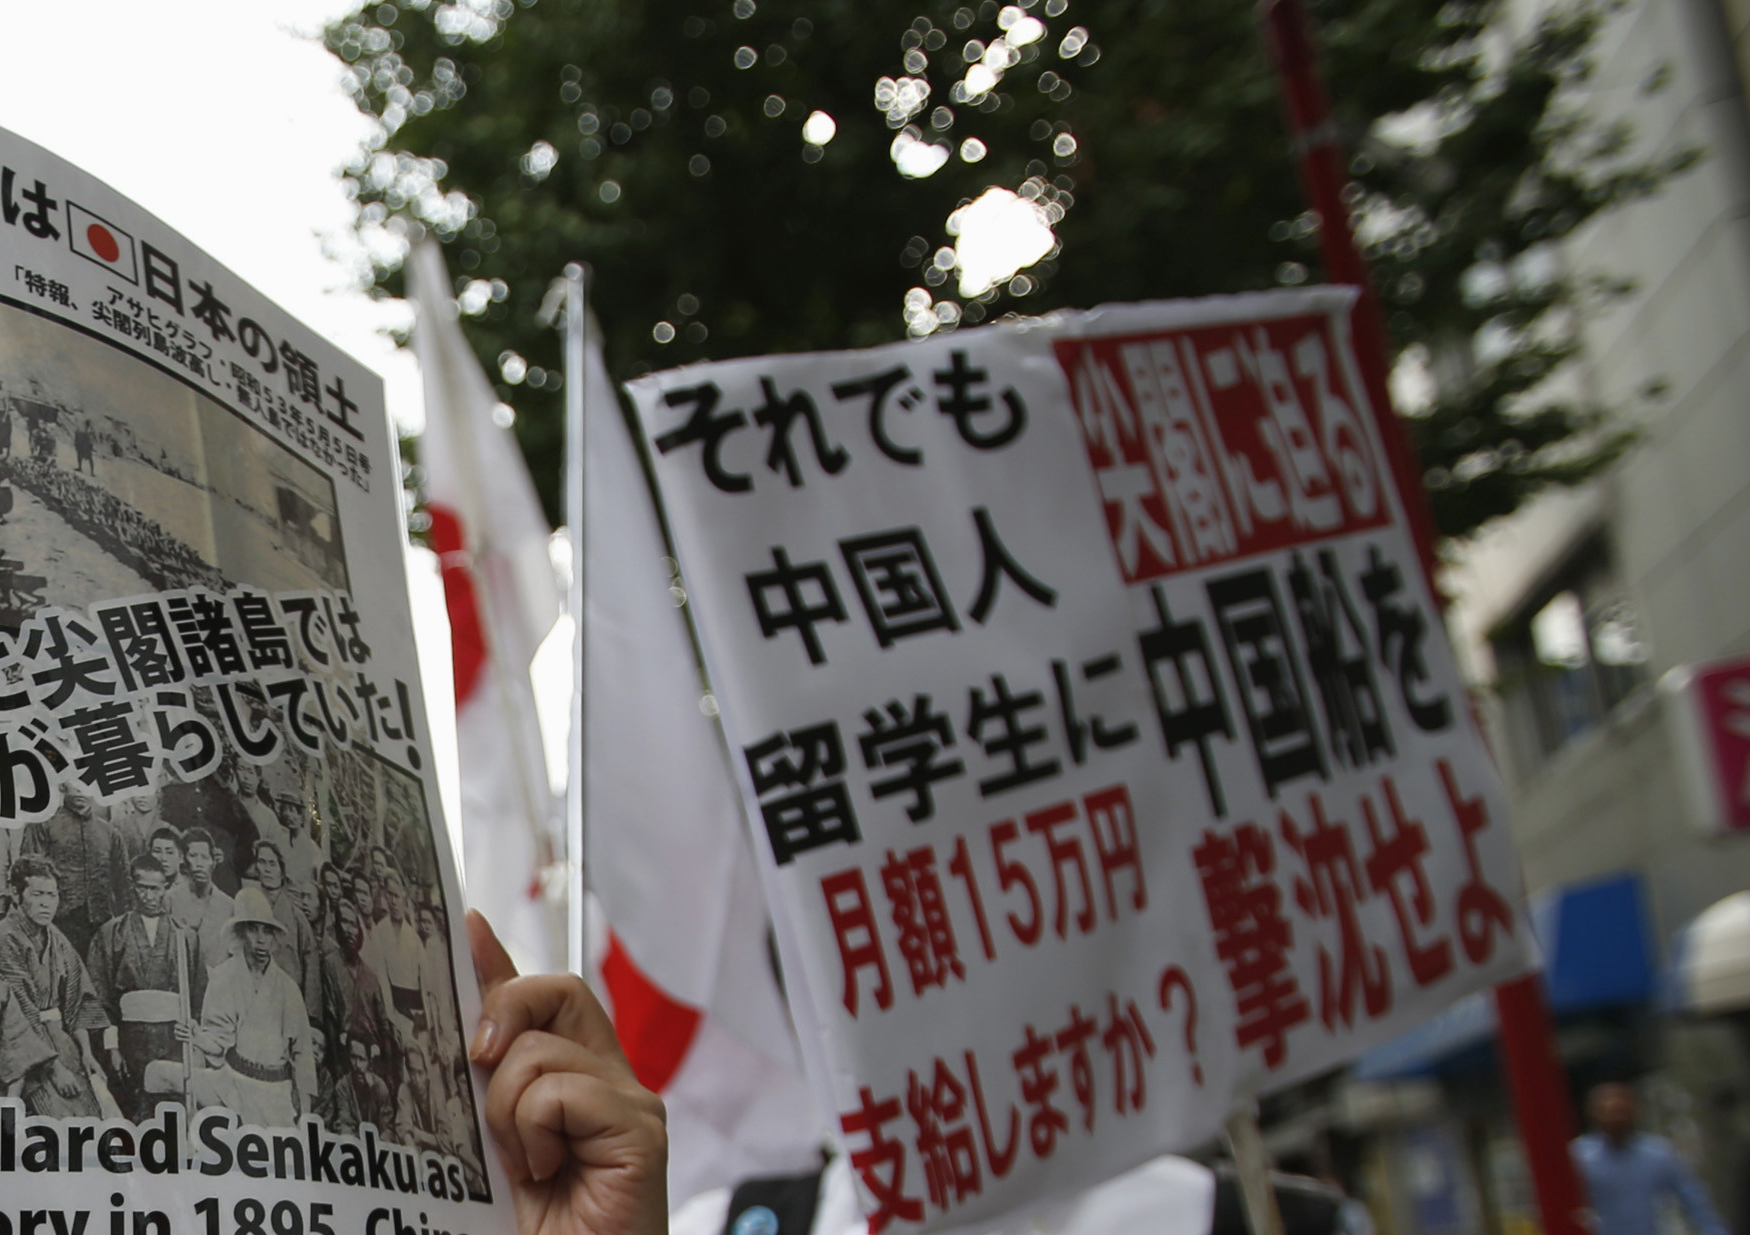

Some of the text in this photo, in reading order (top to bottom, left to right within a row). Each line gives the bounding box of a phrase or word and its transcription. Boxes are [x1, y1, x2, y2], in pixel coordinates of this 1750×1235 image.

[141, 240, 366, 443] 日本の領土
[654, 350, 1028, 495] それでも
[1078, 338, 1386, 568] 尖閣に迫る
[744, 506, 1057, 667] 中国人
[1138, 543, 1447, 820] 中国船を
[744, 652, 1140, 866] 留学生に
[819, 786, 1150, 1022] 月額15万円
[1192, 761, 1518, 1074] 撃沈せよ
[198, 1114, 418, 1194] Senkaku
[427, 1157, 466, 1203] as
